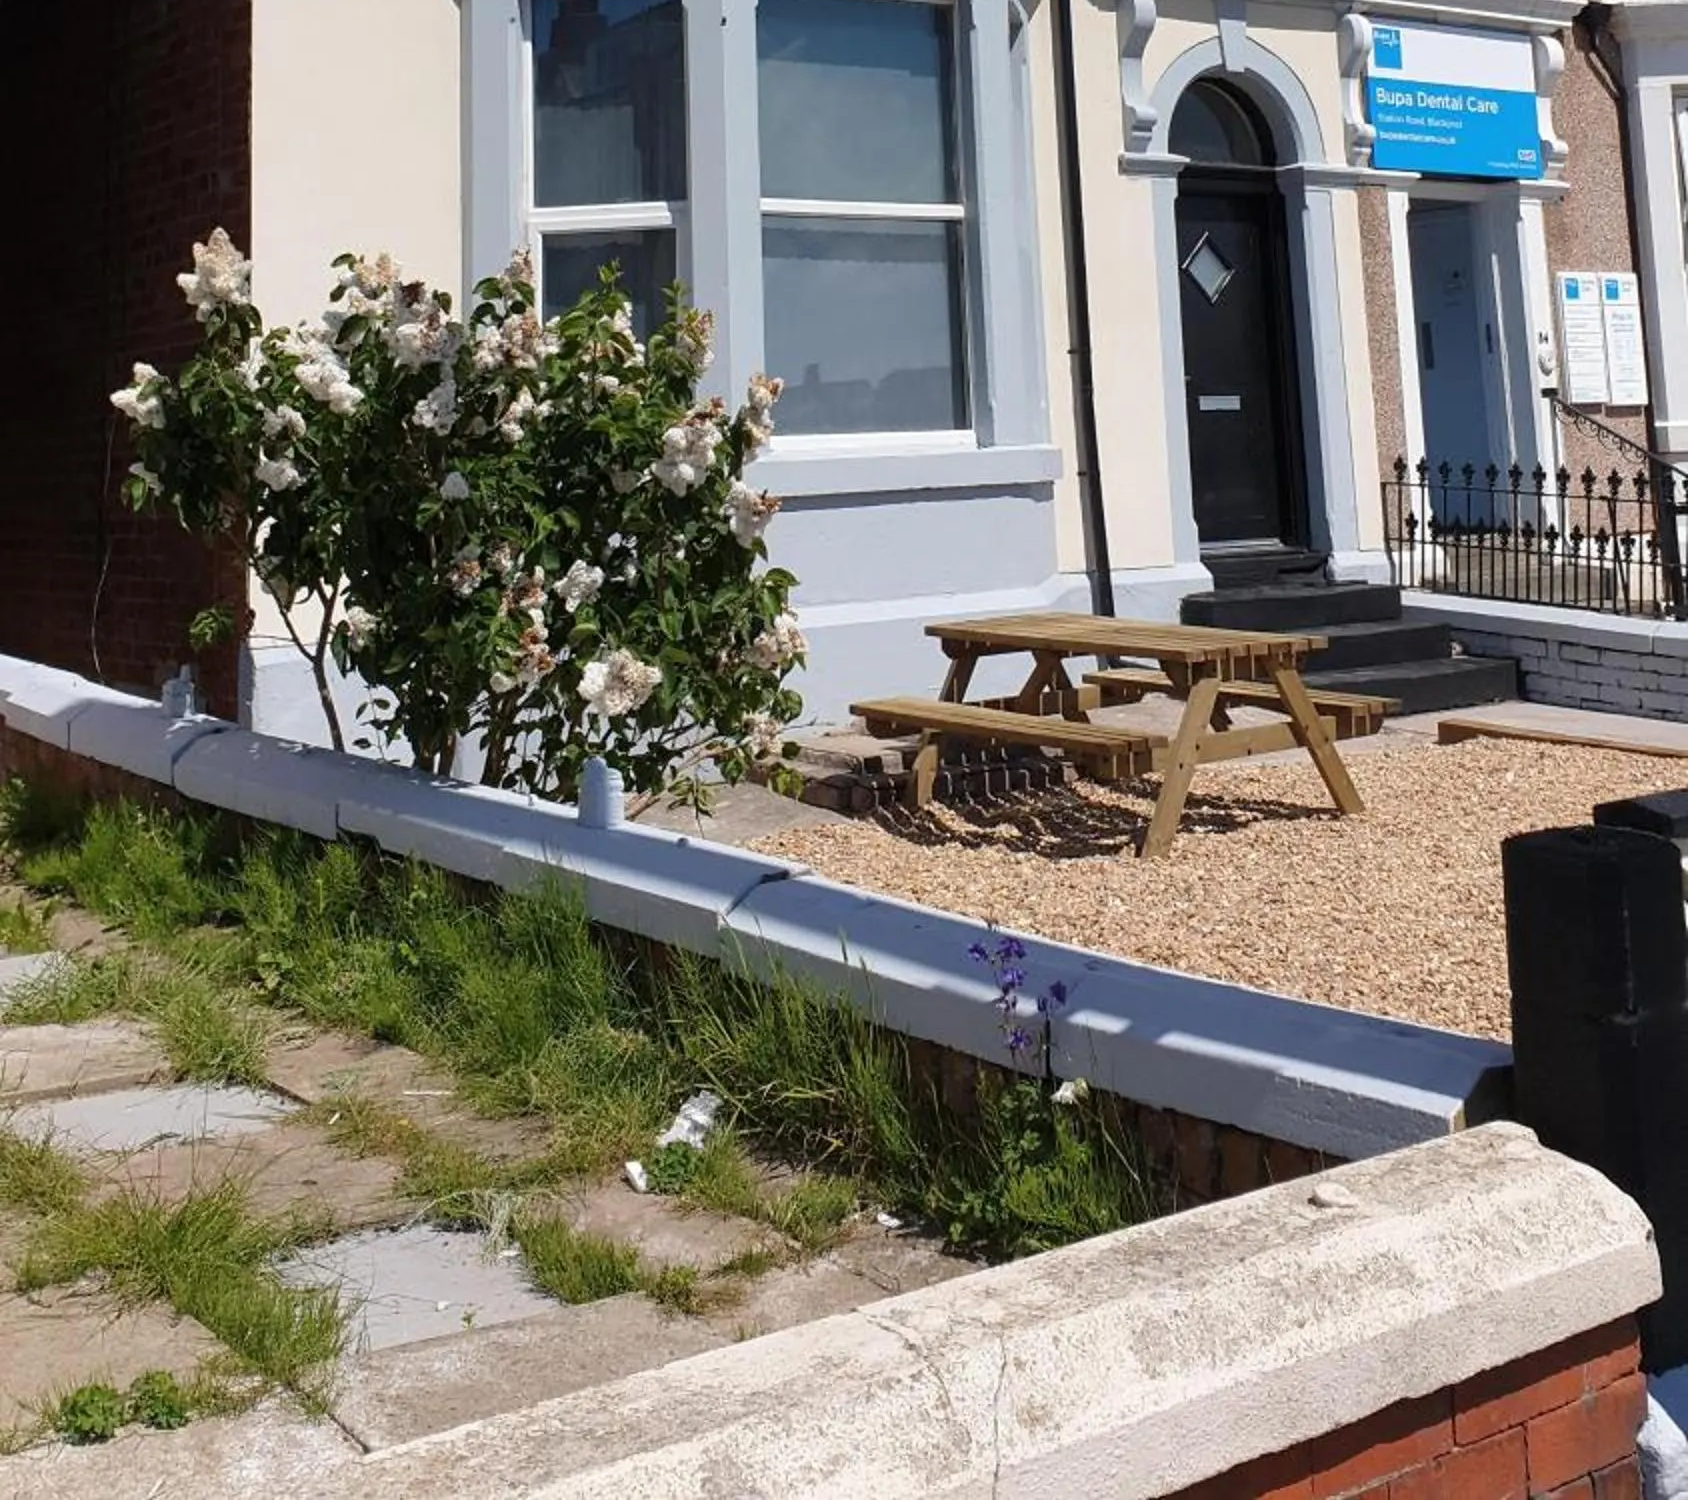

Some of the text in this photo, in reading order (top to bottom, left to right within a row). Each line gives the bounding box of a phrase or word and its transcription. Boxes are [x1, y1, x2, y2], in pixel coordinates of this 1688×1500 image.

[1376, 87, 1499, 114] Bupa Dental Care
